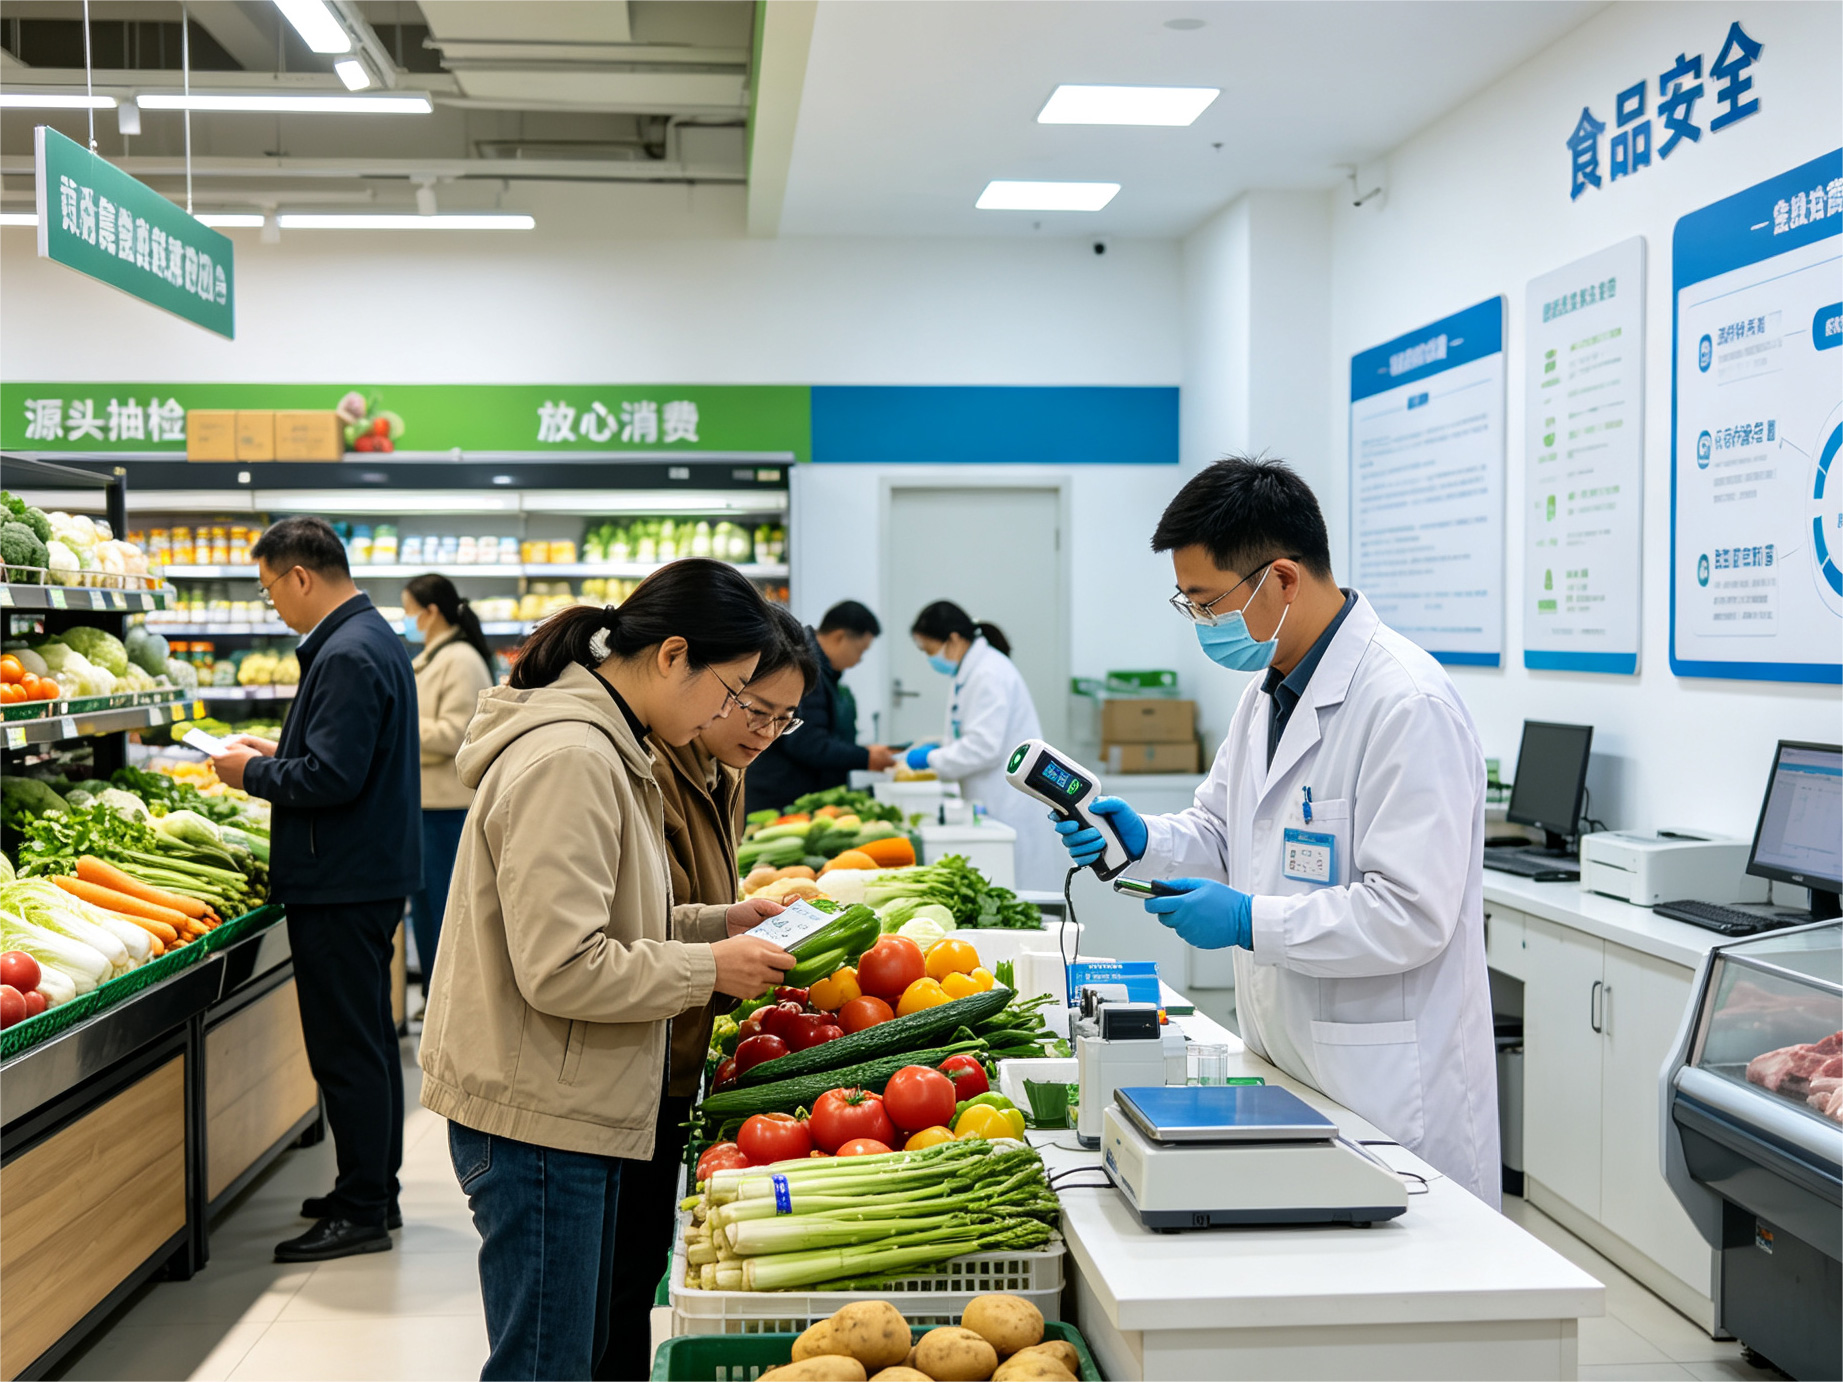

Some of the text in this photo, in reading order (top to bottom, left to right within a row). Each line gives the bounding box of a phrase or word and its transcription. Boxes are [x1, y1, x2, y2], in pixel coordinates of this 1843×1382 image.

[1566, 21, 1765, 202] 食品安全
[24, 397, 186, 442] 源头抽检
[537, 400, 699, 443] 放心消费
